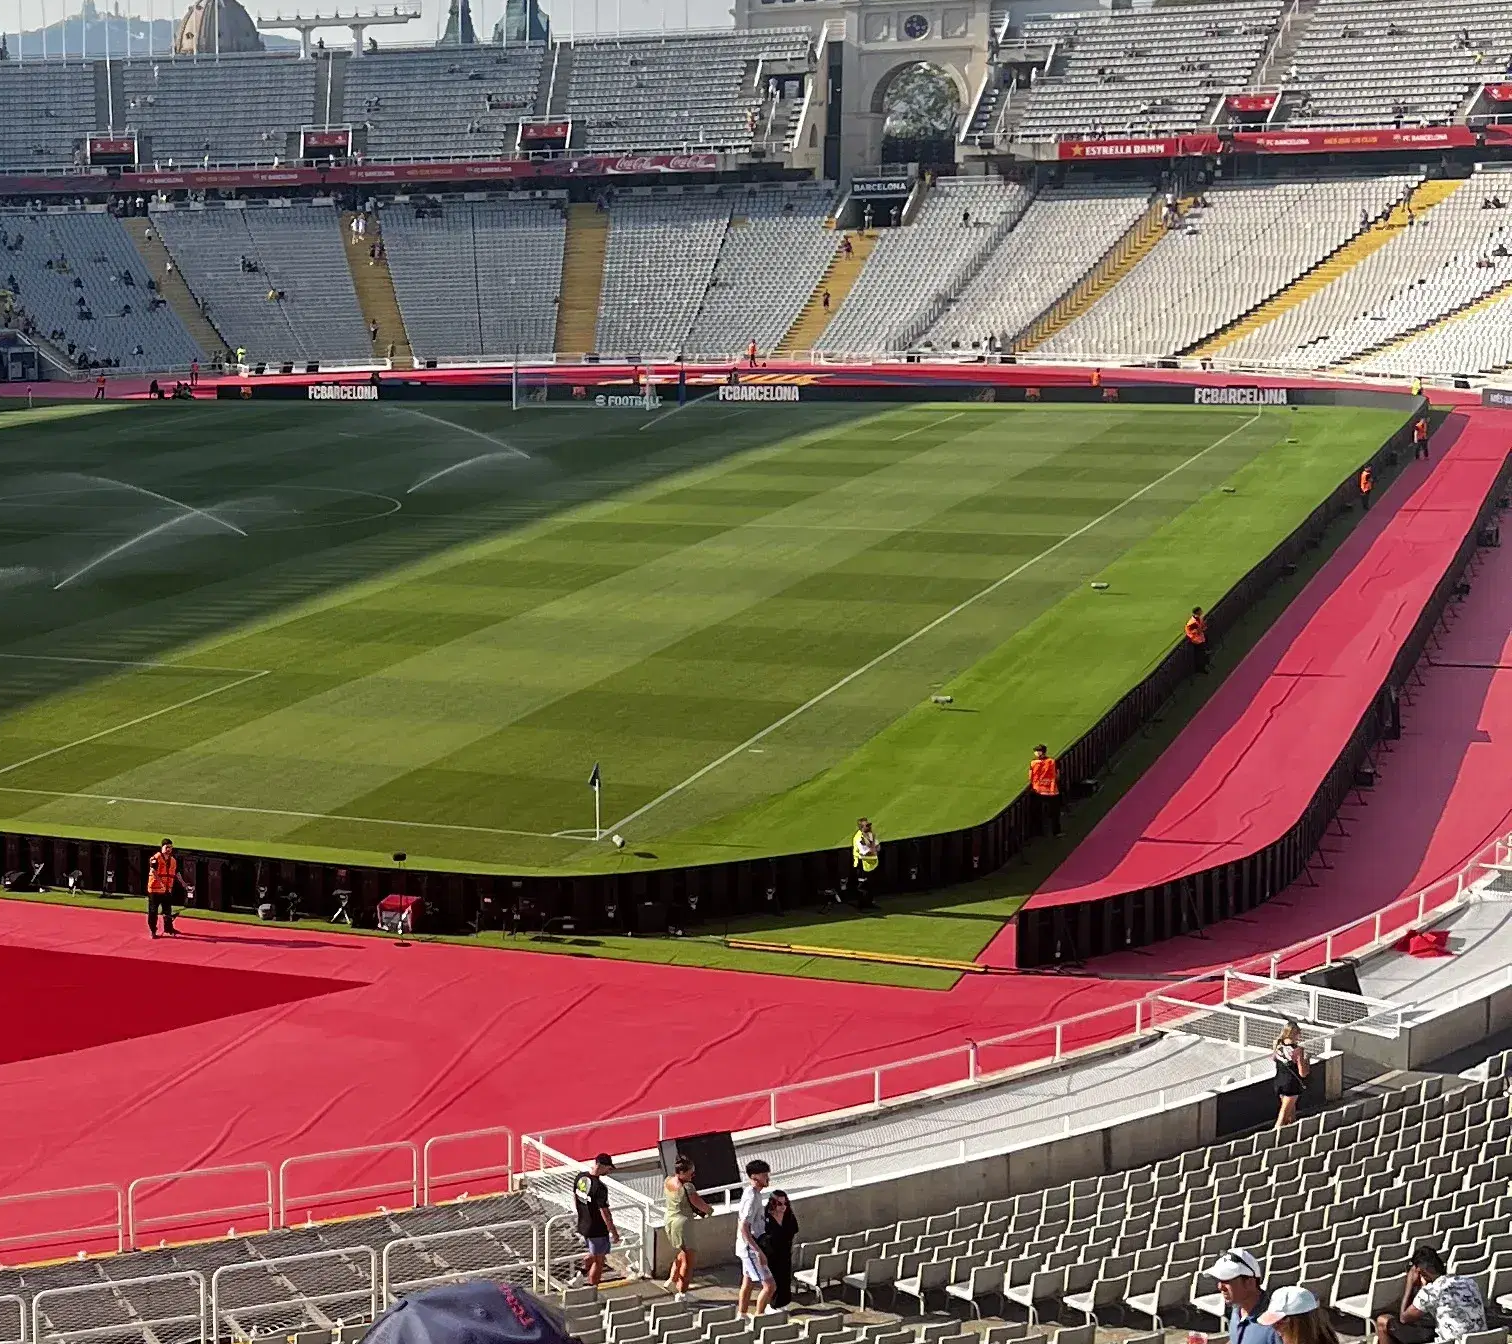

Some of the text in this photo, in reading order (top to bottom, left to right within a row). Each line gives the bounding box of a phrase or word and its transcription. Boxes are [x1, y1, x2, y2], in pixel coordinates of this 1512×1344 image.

[1085, 144, 1165, 155] ESTRELLA DAMM
[853, 182, 907, 192] BARCELONA
